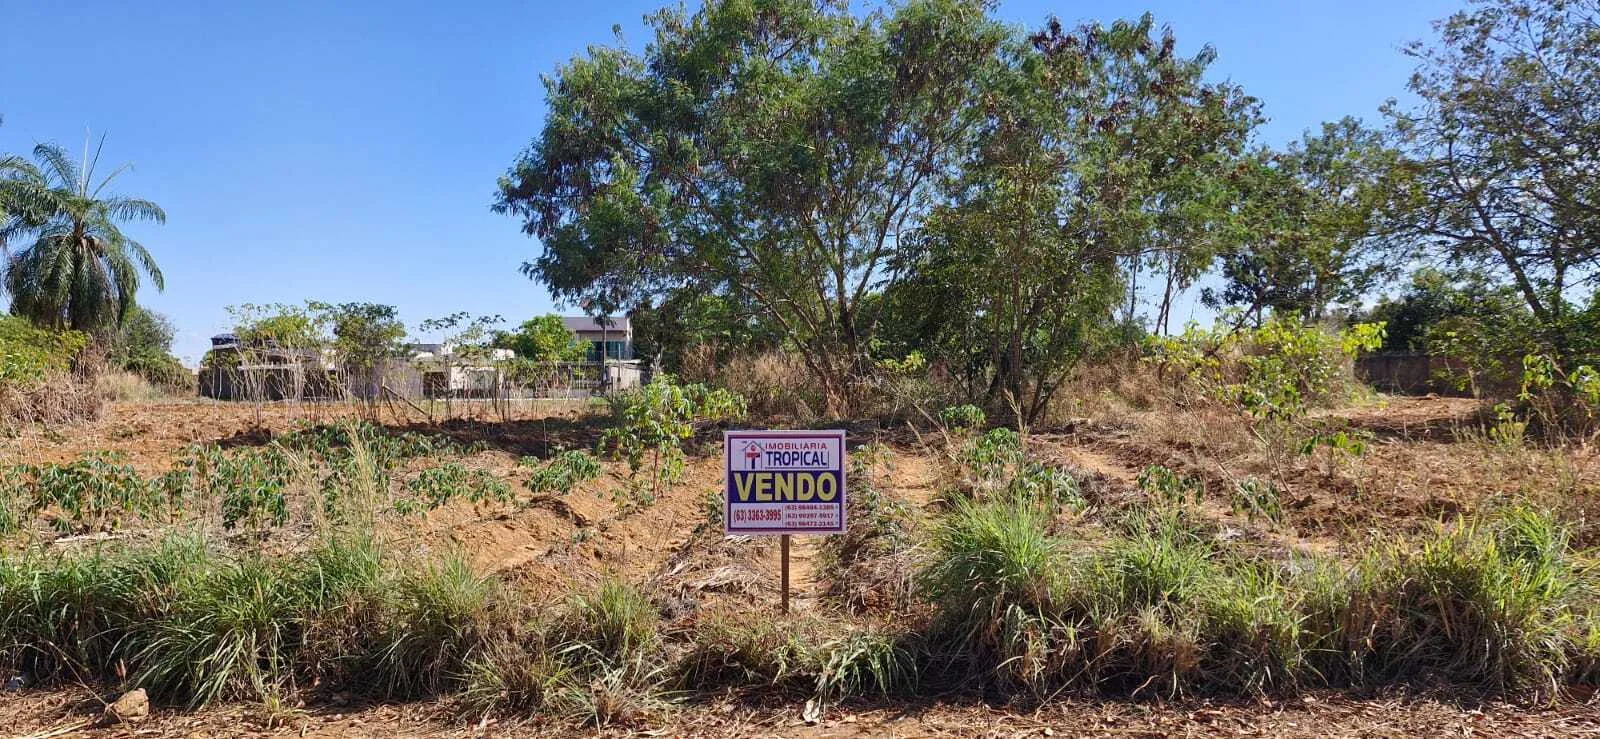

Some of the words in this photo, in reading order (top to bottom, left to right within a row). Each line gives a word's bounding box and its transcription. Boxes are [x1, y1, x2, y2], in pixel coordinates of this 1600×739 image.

[765, 442, 828, 451] IMOBILIARIA
[765, 451, 827, 466] TROPICAL
[734, 472, 838, 502] VENDO
[733, 508, 746, 523] (63)
[747, 508, 782, 521] 3363-3995
